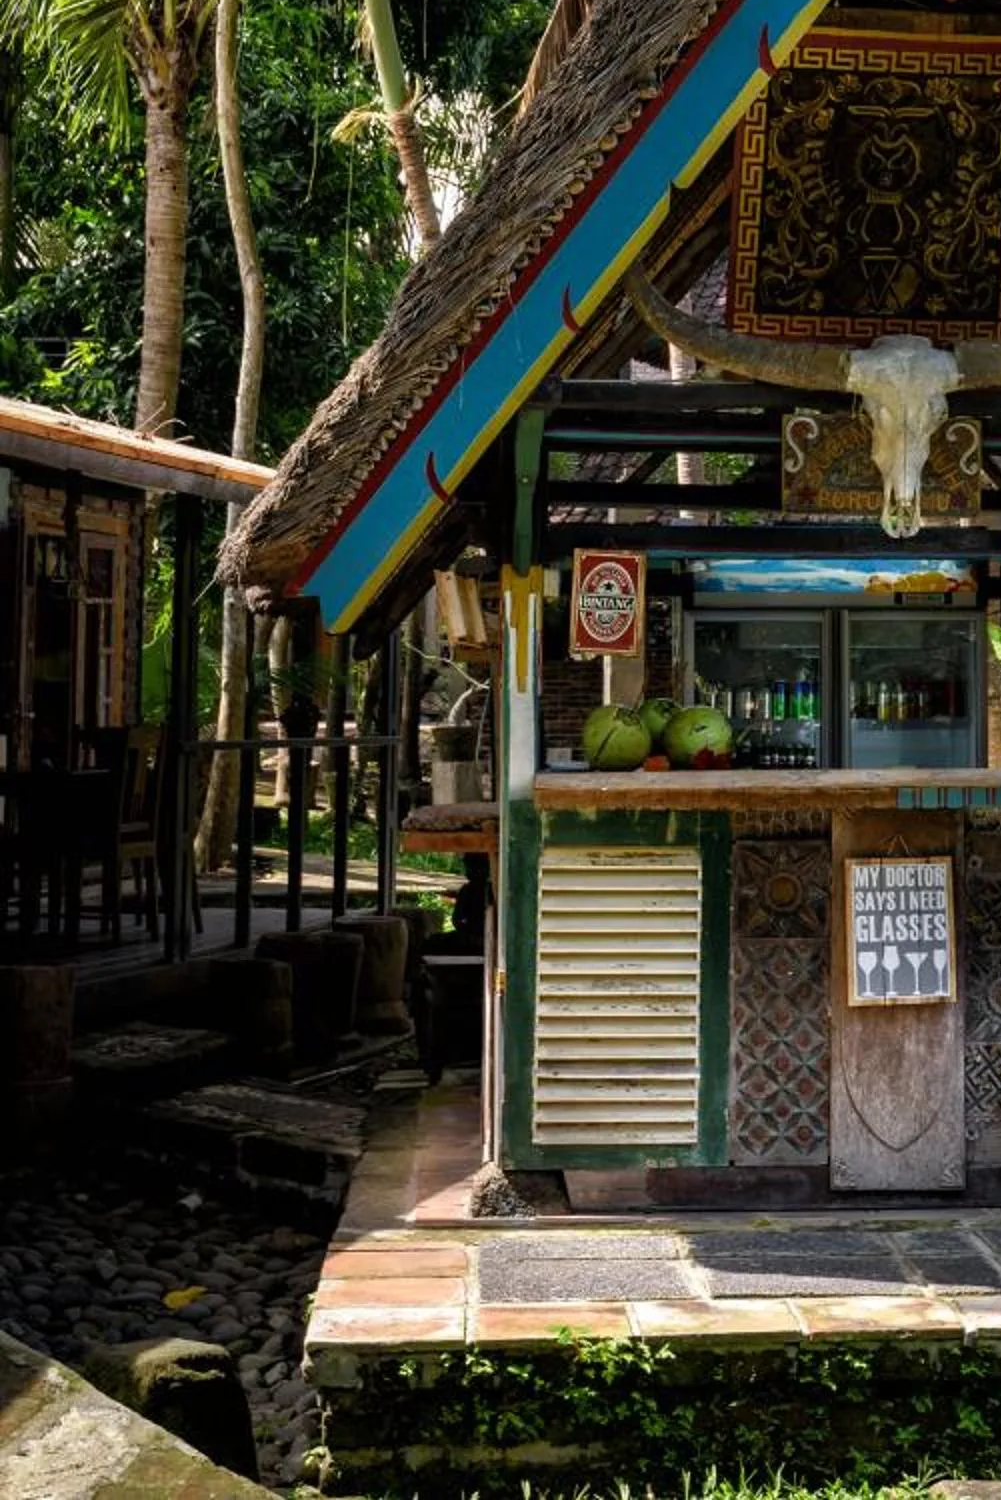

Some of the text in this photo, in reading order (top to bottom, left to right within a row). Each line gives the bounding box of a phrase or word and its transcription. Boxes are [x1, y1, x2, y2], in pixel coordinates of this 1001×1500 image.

[580, 595, 635, 611] BINTANG
[855, 865, 945, 888] MY DOCTOR
[855, 890, 945, 911] SAYS I NEED
[855, 913, 947, 942] GLASSES
